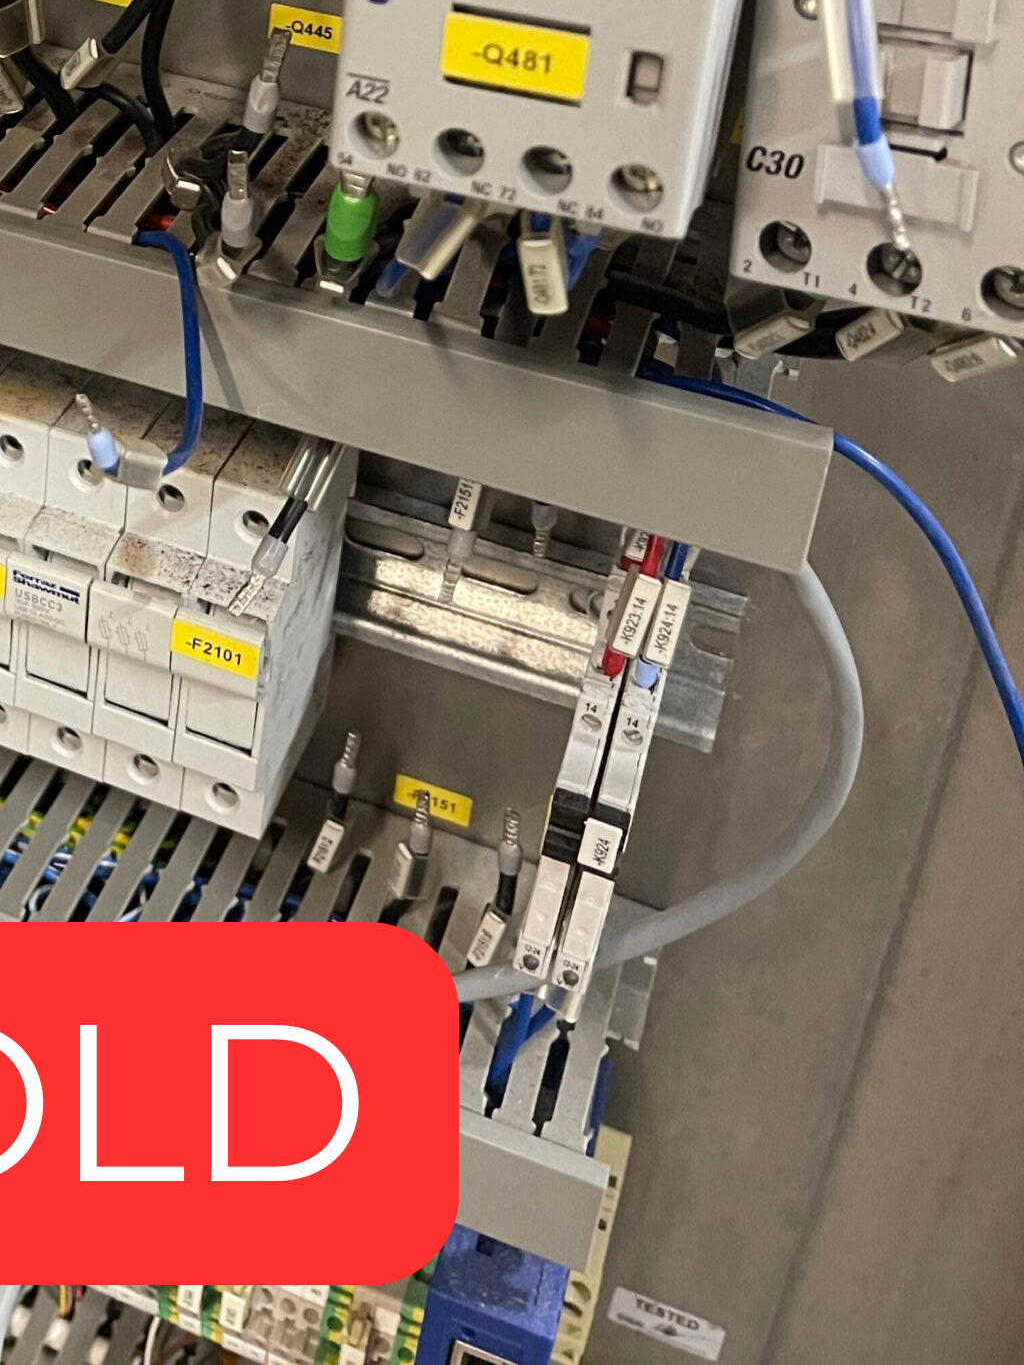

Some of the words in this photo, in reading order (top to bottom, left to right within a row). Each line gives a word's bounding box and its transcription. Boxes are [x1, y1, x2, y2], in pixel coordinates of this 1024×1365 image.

[285, 18, 333, 41] -Q445
[472, 43, 553, 75] -Q481
[345, 78, 391, 104] A22
[745, 146, 806, 180] C30
[471, 180, 491, 197] NC
[499, 186, 517, 202] 72
[557, 198, 578, 215] NC
[742, 259, 753, 273] 2
[802, 272, 820, 288] T1
[848, 282, 858, 296] 4
[909, 295, 932, 313] T2
[13, 569, 58, 591] Ferraz
[13, 575, 81, 605] Shawmut
[15, 588, 64, 613] USBCC3
[620, 596, 648, 646] -K923:14
[656, 603, 679, 655] -K924:14
[185, 636, 243, 666] -F2101
[585, 702, 598, 714] 14
[626, 717, 639, 729] 14
[595, 837, 611, 866] -K924
[635, 1298, 700, 1331] TESTED
